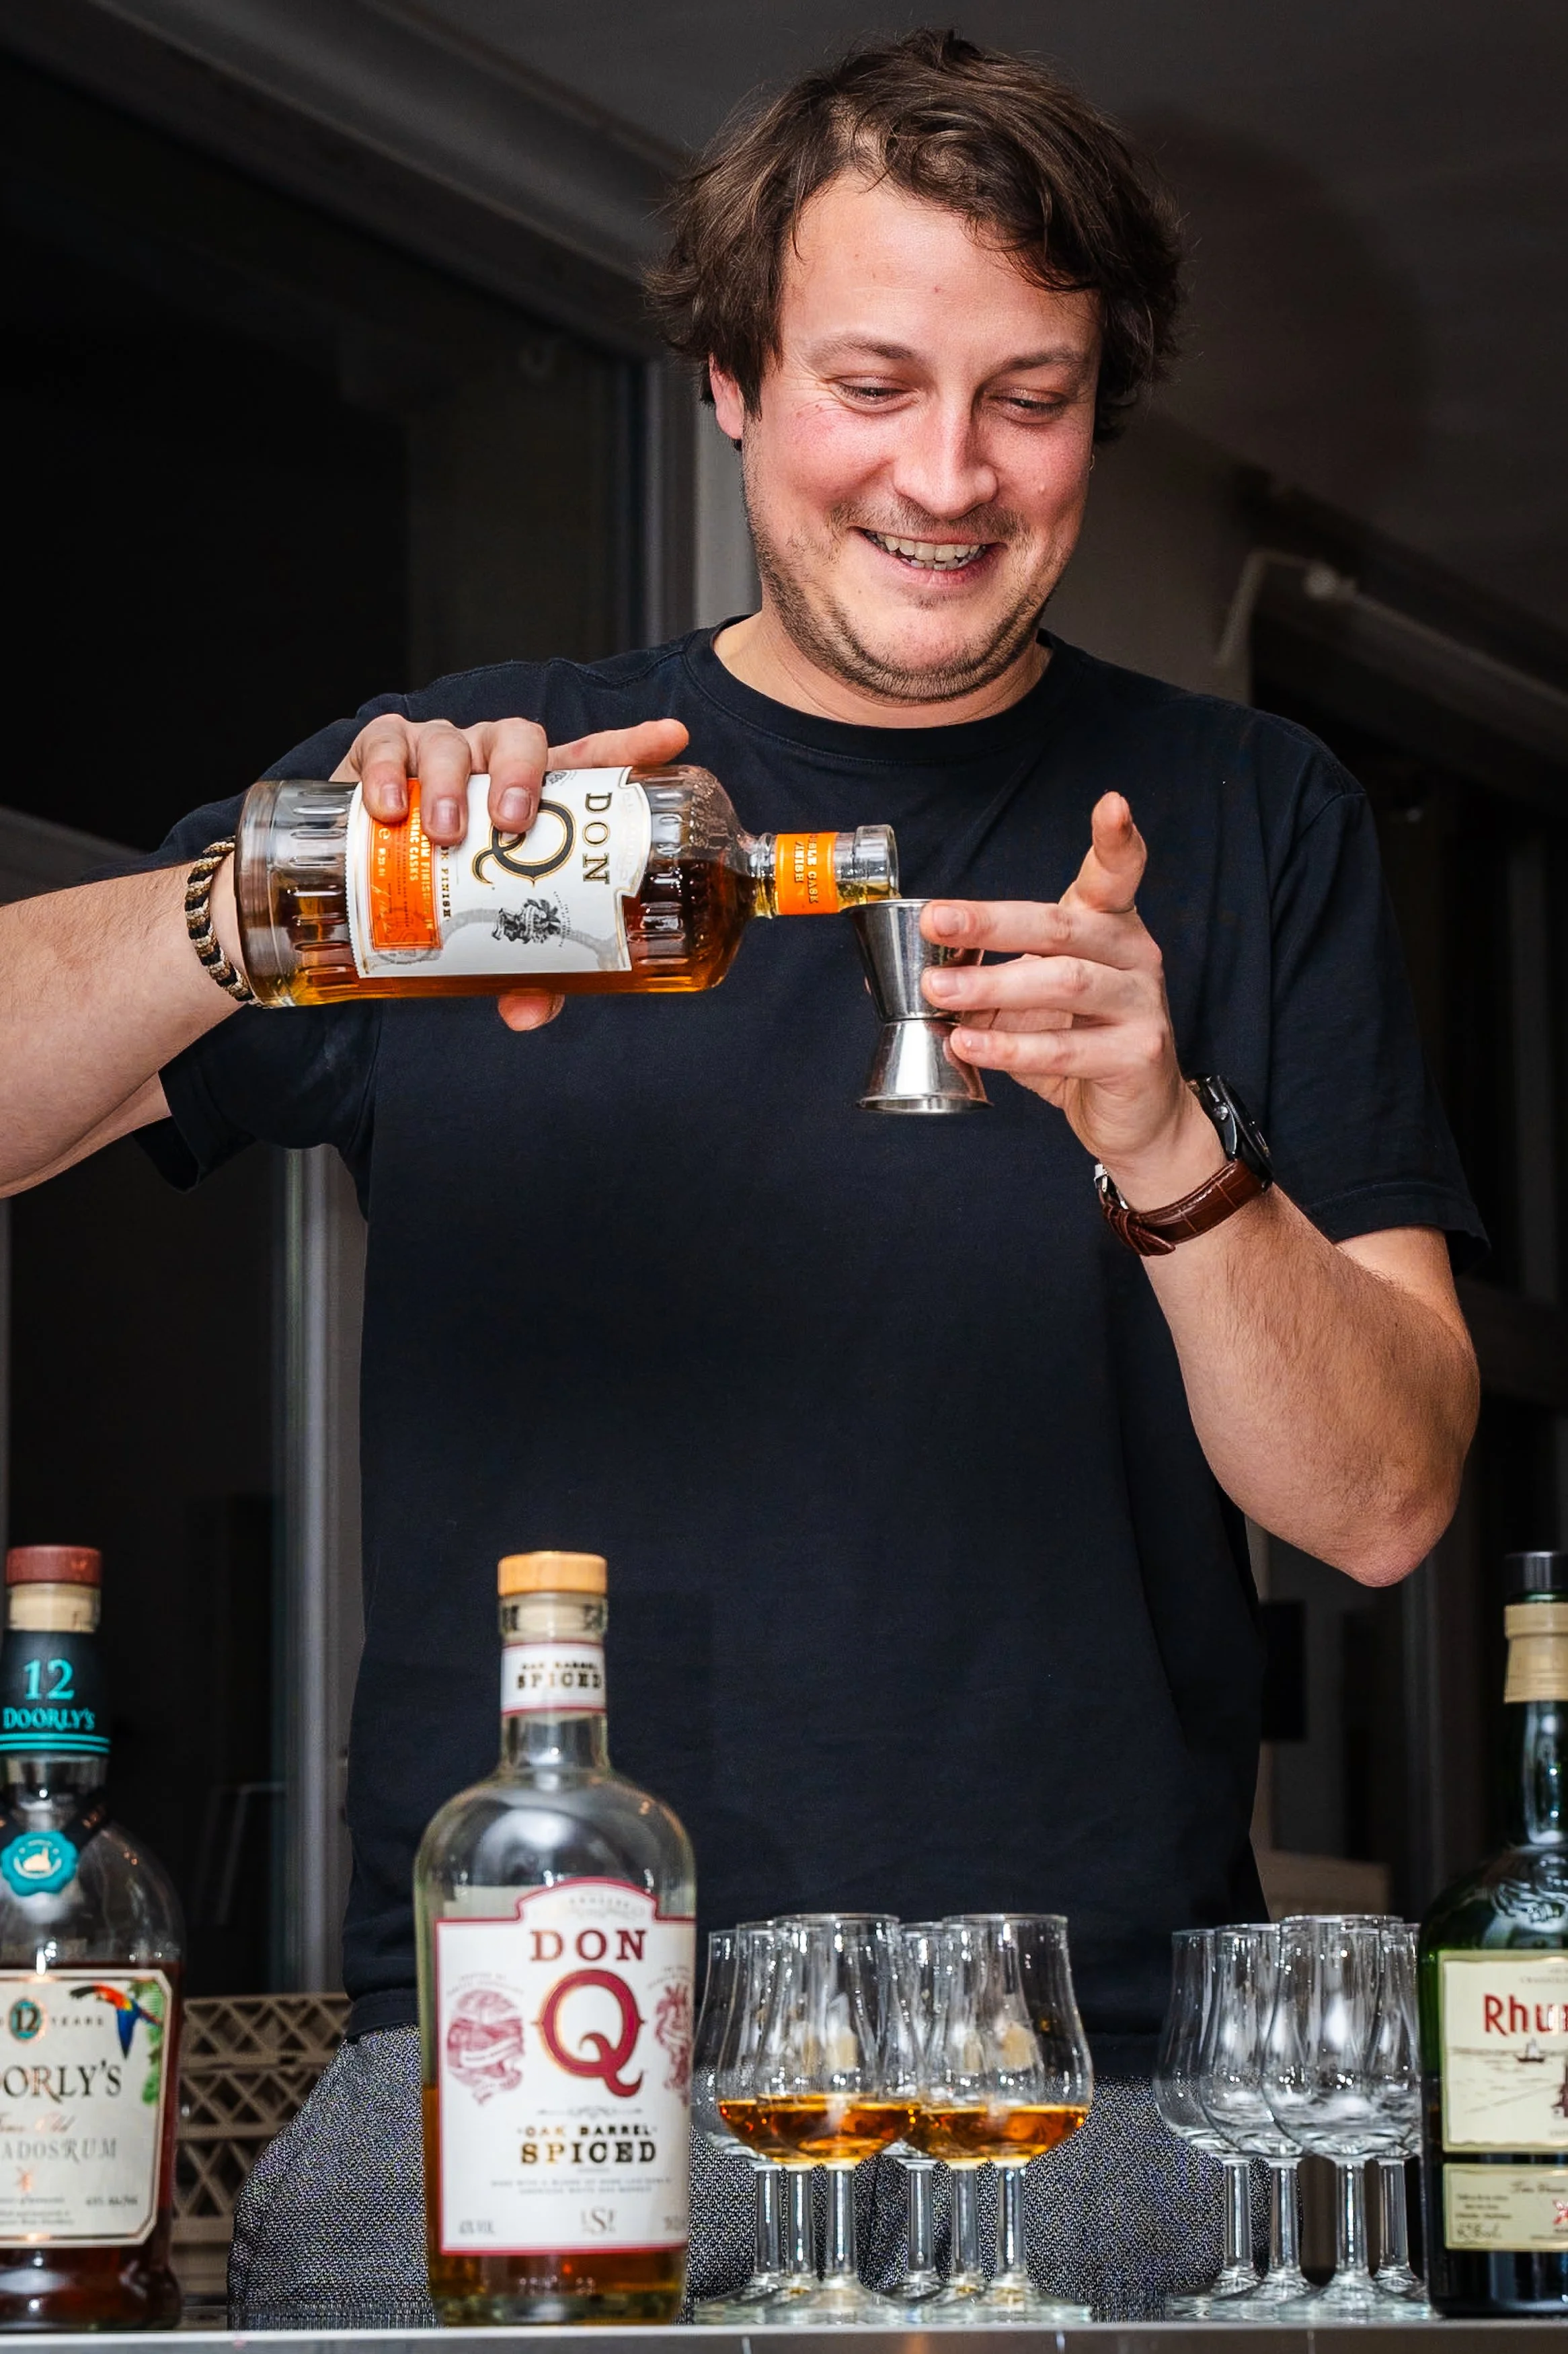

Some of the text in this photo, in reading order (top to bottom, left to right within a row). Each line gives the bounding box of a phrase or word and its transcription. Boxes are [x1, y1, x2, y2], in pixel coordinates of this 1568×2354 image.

[379, 827, 391, 841] e
[472, 798, 577, 888] Q
[582, 792, 613, 885] DON
[409, 846, 420, 881] CASKS
[442, 868, 452, 918] FINISH
[807, 870, 819, 904] CASK
[24, 1659, 75, 1700] 12
[3, 1706, 95, 1731] DOORLY'S
[530, 1929, 647, 1961] DON
[16, 2007, 40, 2032] 12
[533, 1968, 645, 2097] Q
[0, 2058, 122, 2103] ORLY'S
[525, 2124, 650, 2136] OAK BARREL
[520, 2140, 656, 2165] SPICED
